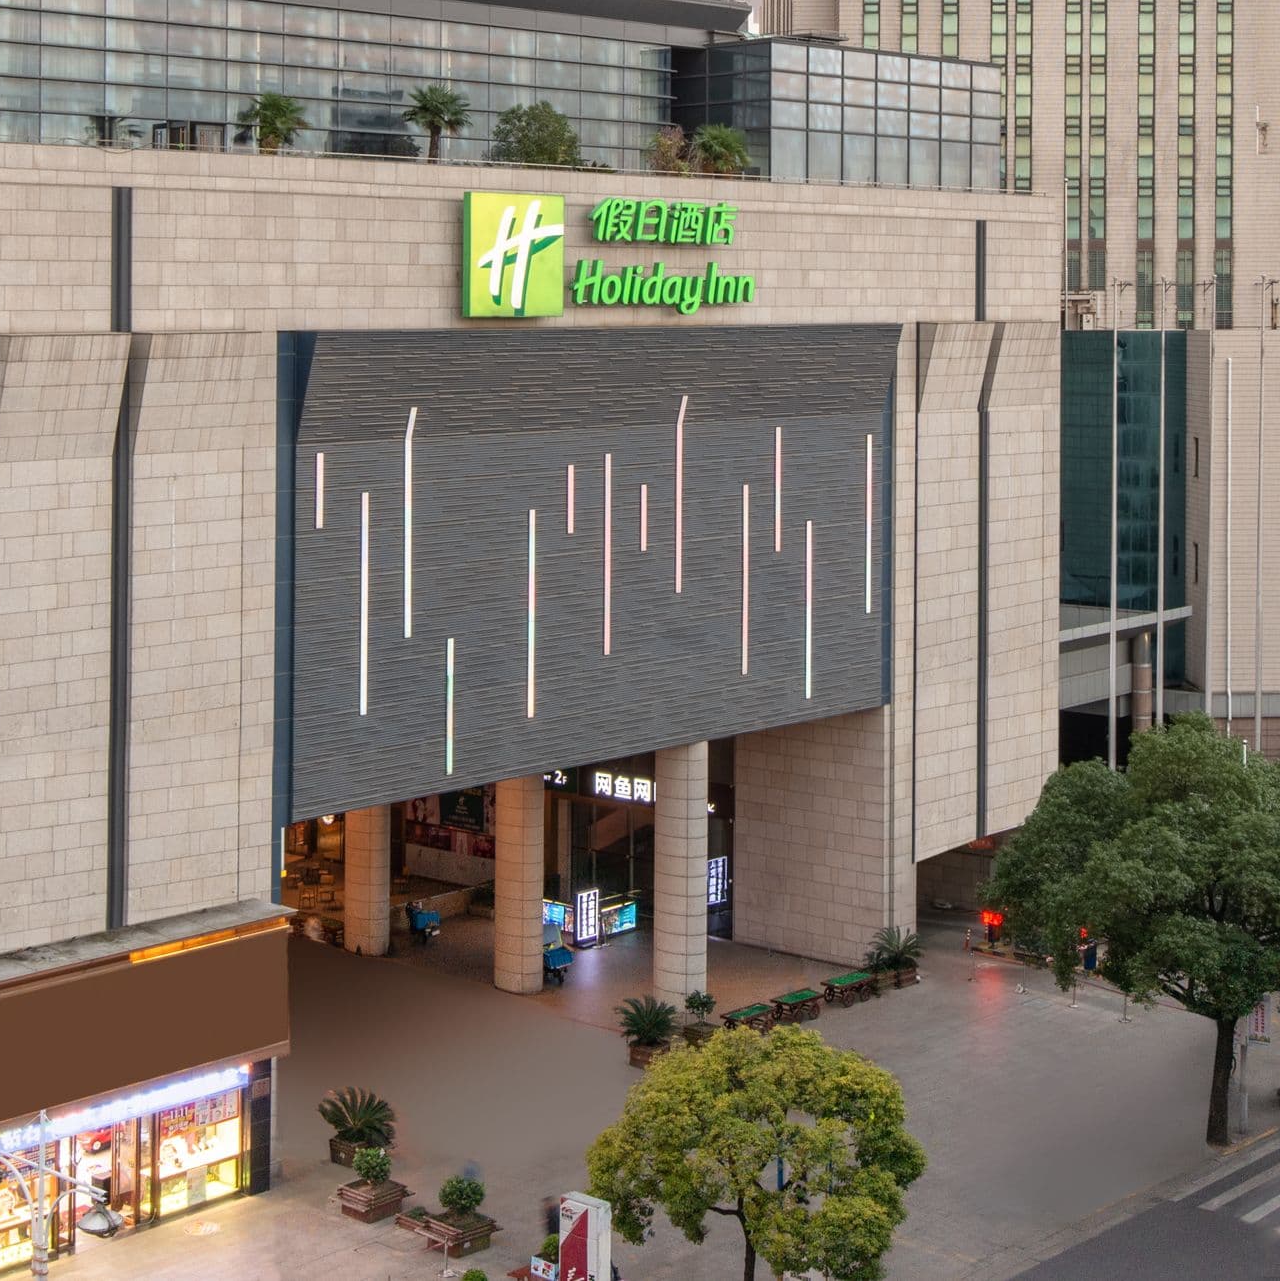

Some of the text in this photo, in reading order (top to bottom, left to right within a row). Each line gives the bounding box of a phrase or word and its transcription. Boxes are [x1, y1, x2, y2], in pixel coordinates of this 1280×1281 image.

[589, 197, 739, 245] 假日酒店
[570, 259, 755, 315] Holiday Inn
[595, 772, 657, 802] 网鱼网
